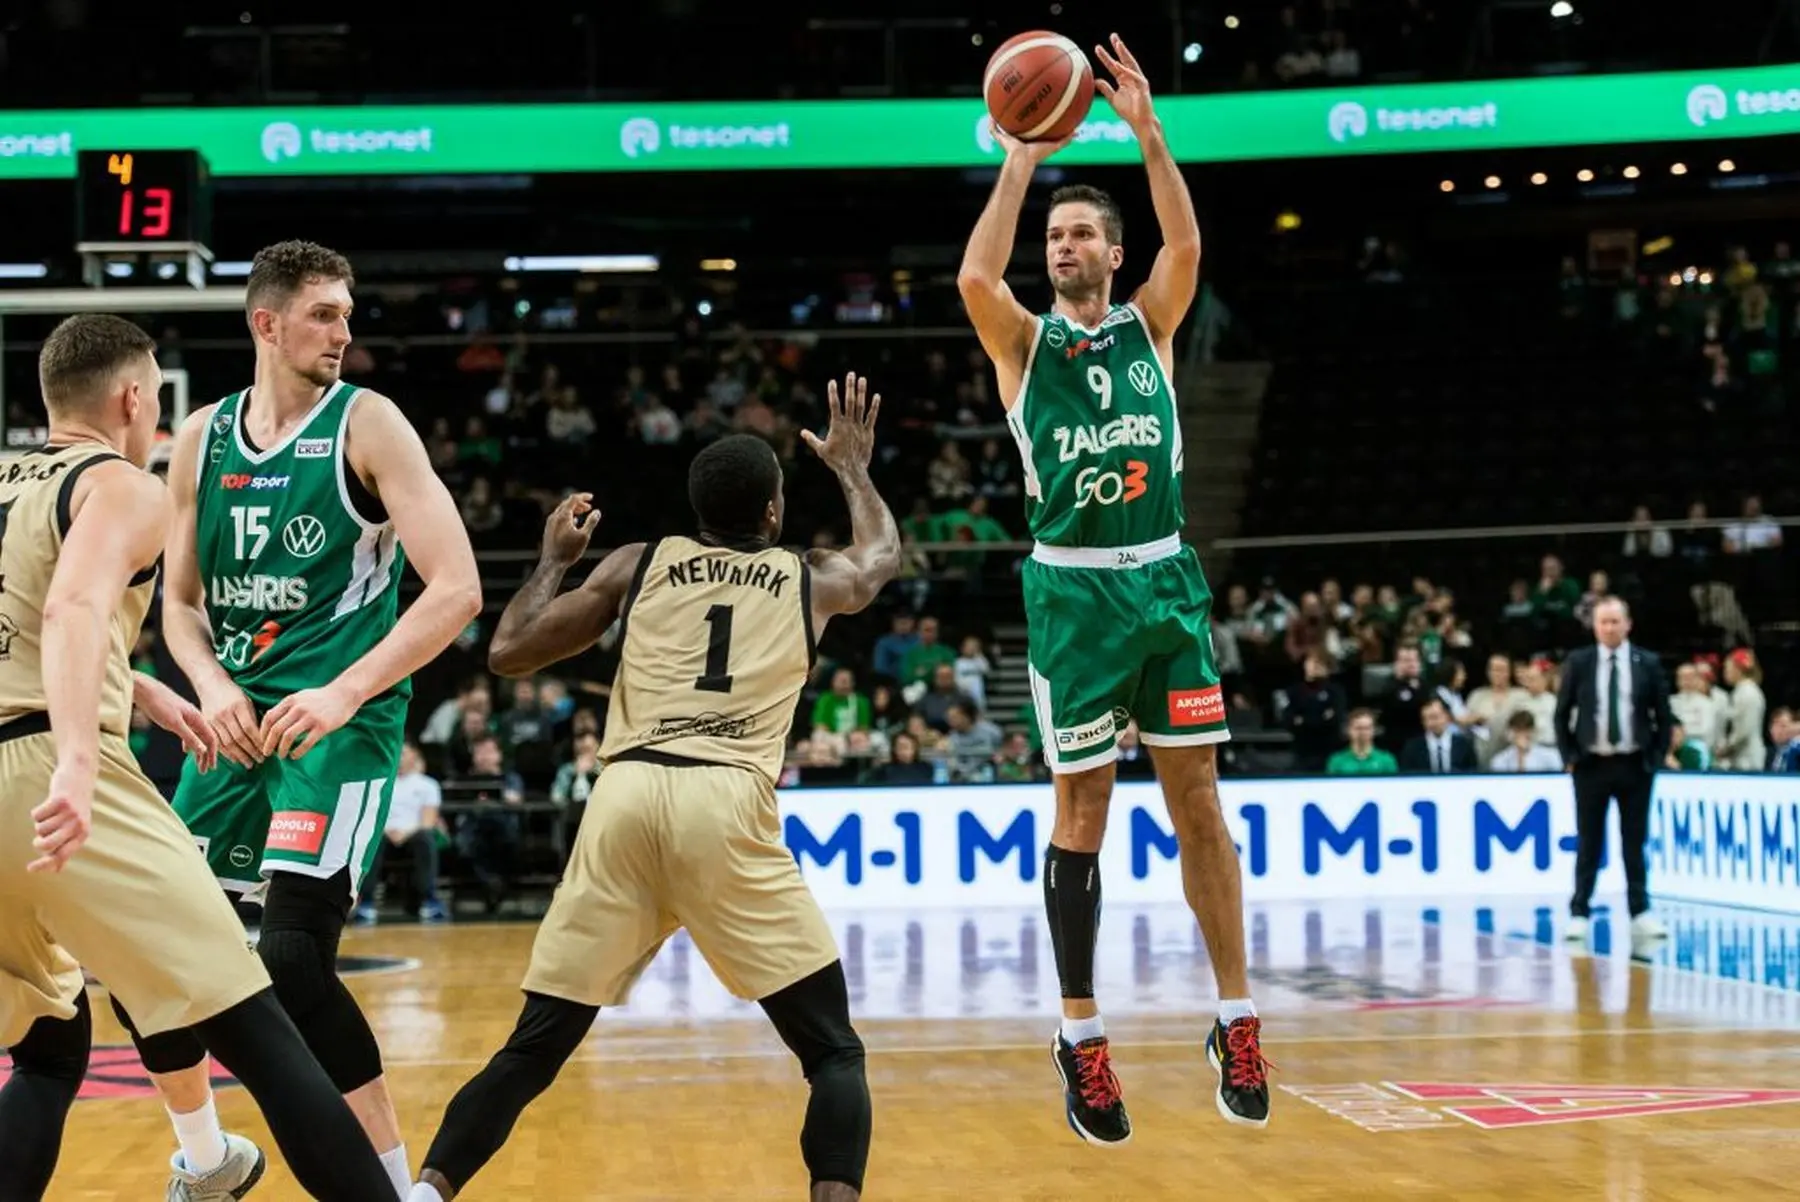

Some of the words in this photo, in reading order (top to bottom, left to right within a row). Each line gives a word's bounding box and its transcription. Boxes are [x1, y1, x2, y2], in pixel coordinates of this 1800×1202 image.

[669, 122, 789, 148] tesonet
[1376, 102, 1497, 131] tesonet
[311, 127, 432, 153] tesonet
[108, 154, 133, 185] 4
[119, 189, 171, 235] 13
[1087, 365, 1112, 410] 9
[1074, 460, 1149, 508] GO3
[230, 506, 271, 560] 15
[694, 604, 734, 693] 1
[784, 811, 921, 885] M-1
[1303, 801, 1438, 875] M-1
